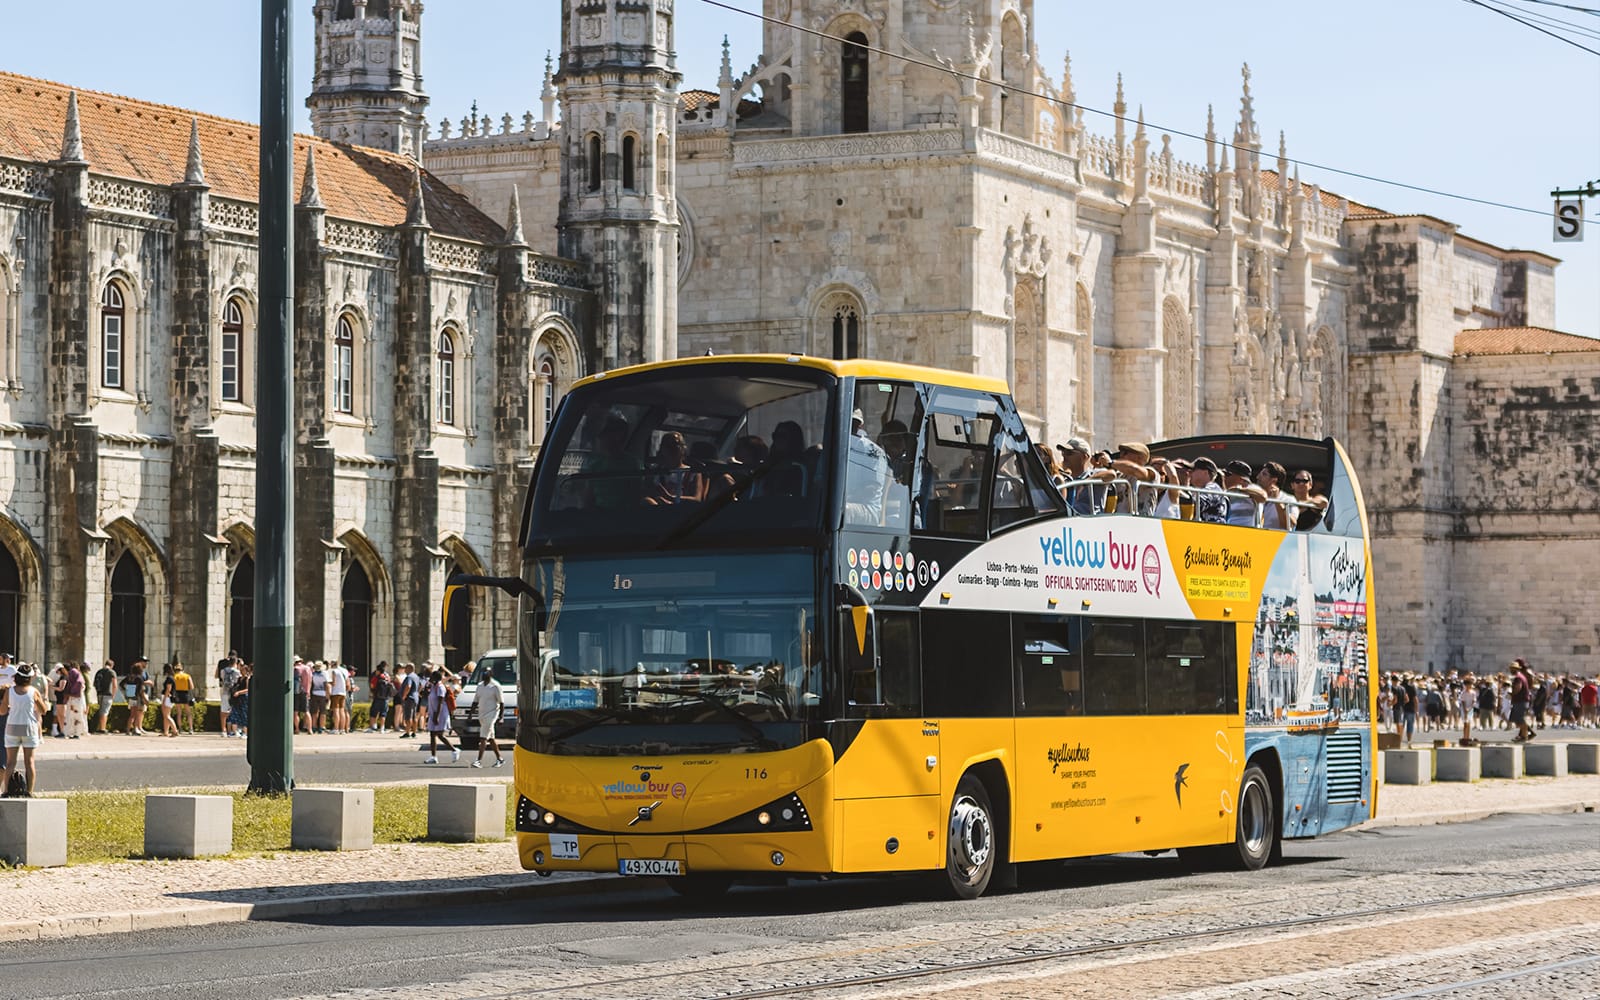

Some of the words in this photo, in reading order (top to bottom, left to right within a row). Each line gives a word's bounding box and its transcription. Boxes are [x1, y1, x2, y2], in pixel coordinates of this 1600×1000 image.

[1558, 205, 1579, 238] S
[1040, 527, 1105, 569] yellow
[1109, 531, 1138, 571] bus
[986, 562, 1002, 572] Lisboa
[1005, 563, 1018, 573] Porto
[1020, 564, 1039, 574] Madeira
[1184, 545, 1219, 569] Exclusive
[1221, 548, 1251, 575] Benefits
[958, 574, 983, 585] Guimarães
[986, 575, 1000, 588] Braga
[1003, 576, 1021, 587] Coimbra
[1045, 575, 1074, 590] OFFICIAL
[1075, 577, 1116, 592] SIGHTSEEING
[1117, 579, 1138, 593] TOURS
[1048, 742, 1089, 774] #yellowbus
[745, 768, 768, 779] 116
[603, 781, 646, 793] yellow
[648, 780, 670, 792] bus
[562, 841, 578, 852] TP
